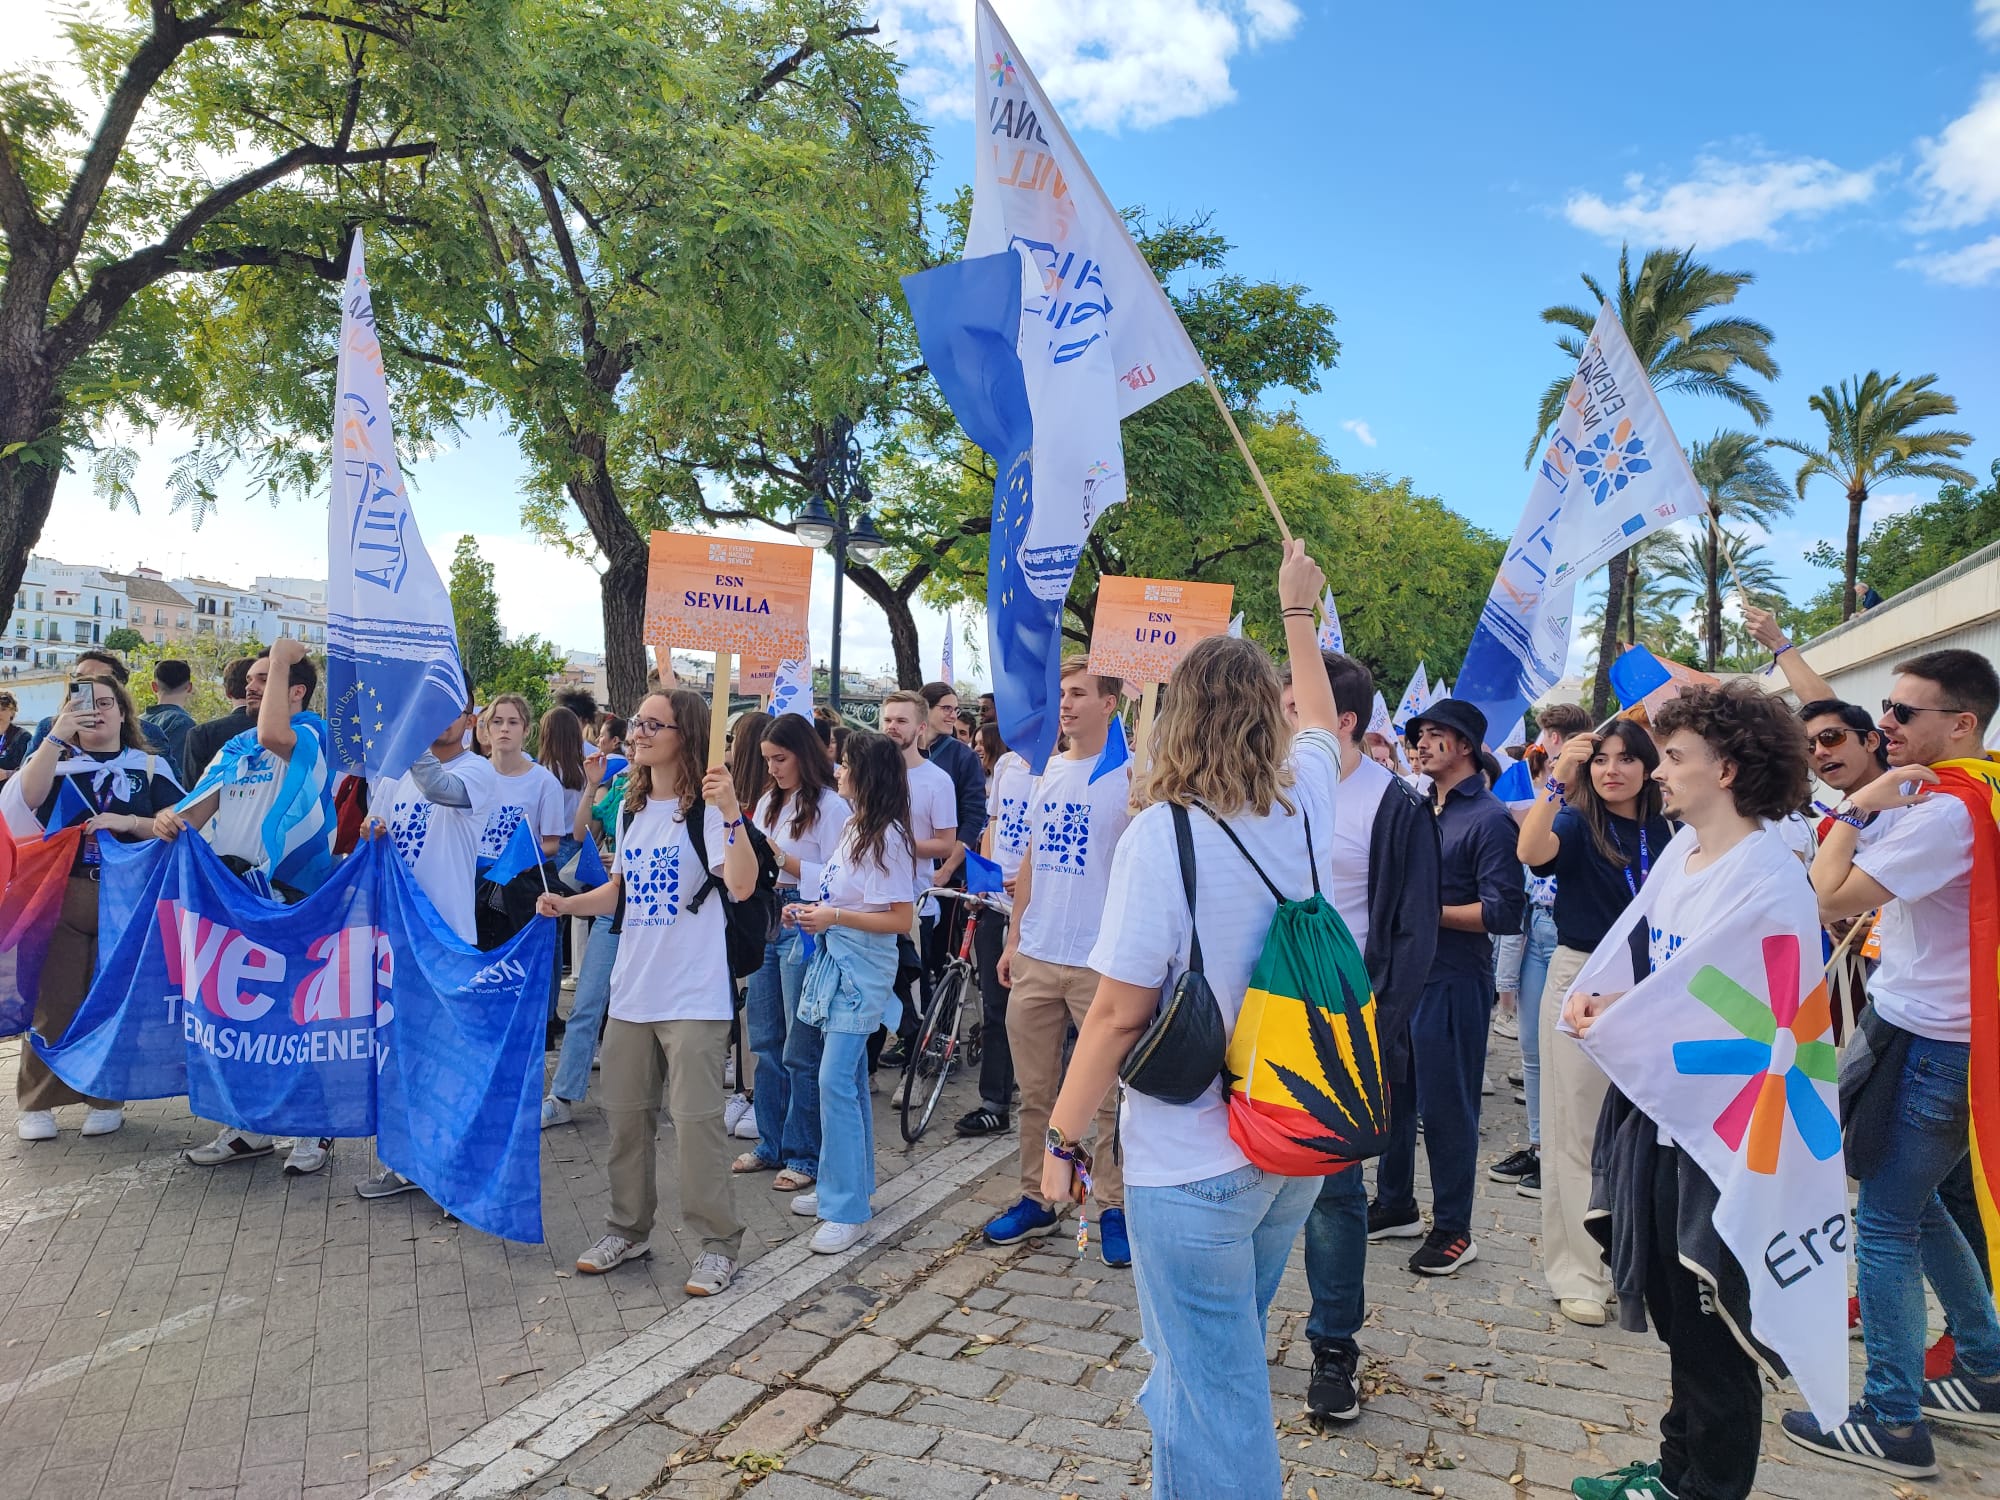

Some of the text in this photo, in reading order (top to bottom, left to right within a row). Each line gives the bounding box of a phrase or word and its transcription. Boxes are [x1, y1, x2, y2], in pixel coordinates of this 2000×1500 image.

[715, 574, 744, 587] ESN
[684, 590, 771, 615] SEVILLA
[1148, 612, 1172, 623] ESN
[1135, 627, 1177, 646] UPO
[1054, 865, 1085, 876] SEVILLA
